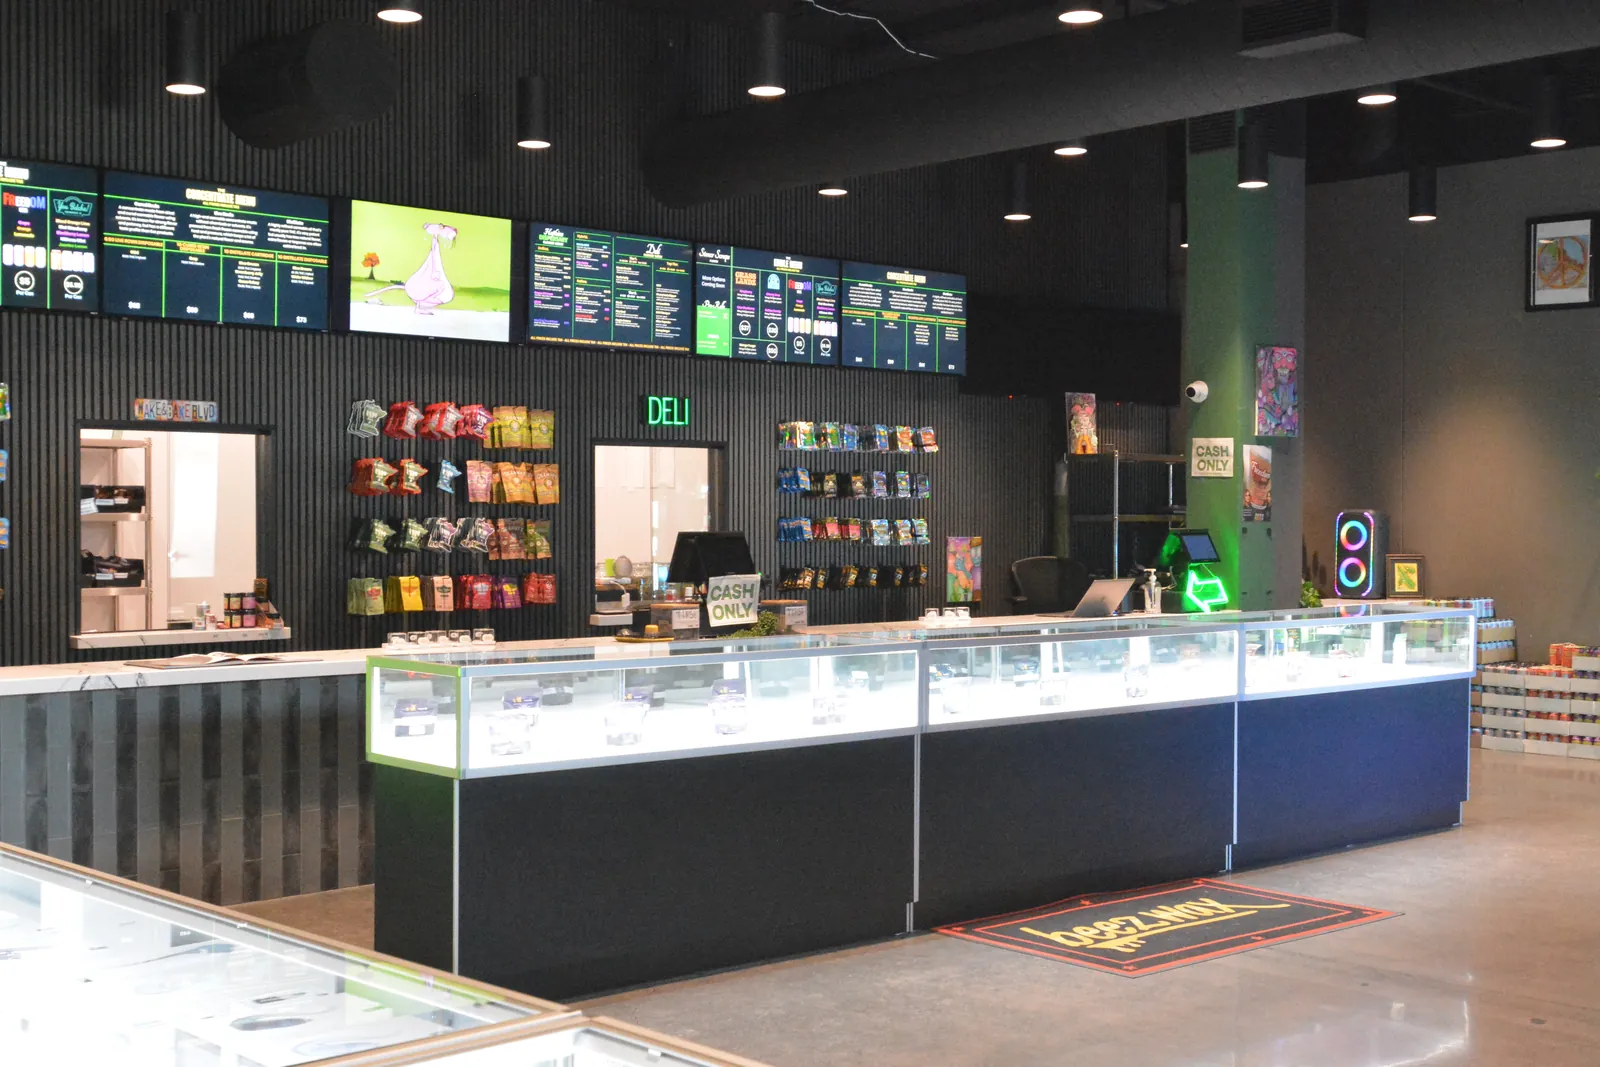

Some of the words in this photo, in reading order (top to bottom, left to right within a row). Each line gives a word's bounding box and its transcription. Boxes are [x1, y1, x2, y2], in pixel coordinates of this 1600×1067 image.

[3, 192, 47, 210] FREEDOM
[735, 271, 757, 280] GRASS
[788, 279, 812, 290] FREEDOM
[192, 404, 215, 420] BLVD
[648, 396, 689, 425] DELI
[1196, 445, 1229, 457] CASH
[1196, 460, 1229, 471] ONLY
[710, 583, 755, 601] CASH
[712, 602, 753, 620] ONLY
[1019, 915, 1171, 948] beez
[1137, 898, 1291, 924] wax
